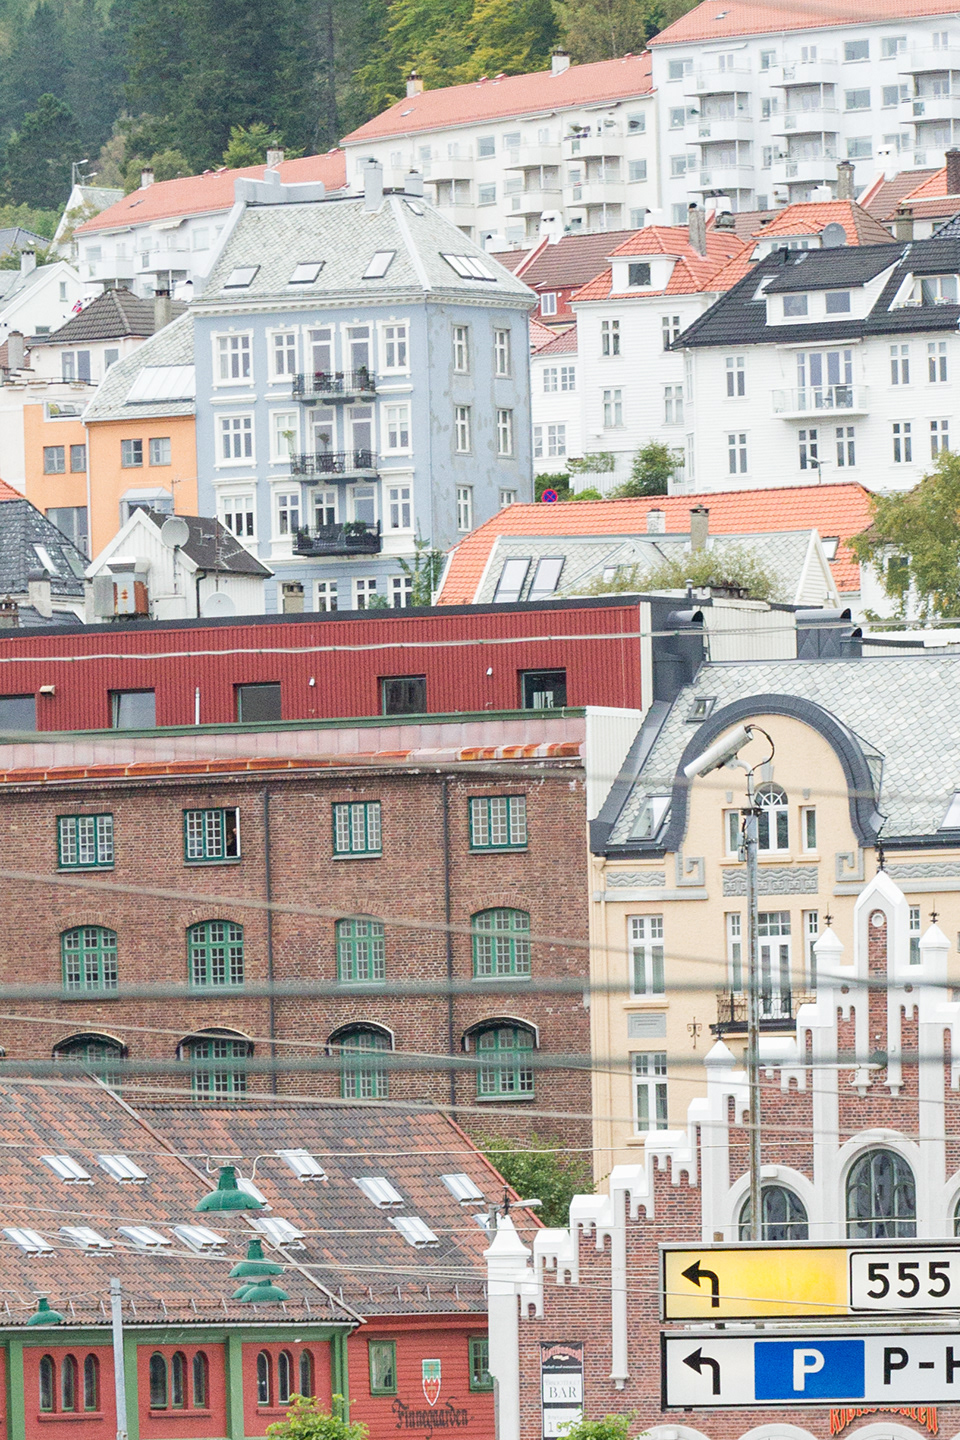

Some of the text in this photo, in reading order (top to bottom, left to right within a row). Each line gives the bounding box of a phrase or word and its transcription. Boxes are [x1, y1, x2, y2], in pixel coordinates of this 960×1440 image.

[867, 1261, 951, 1298] 555
[792, 1348, 825, 1391] P
[549, 1386, 577, 1399] BAR
